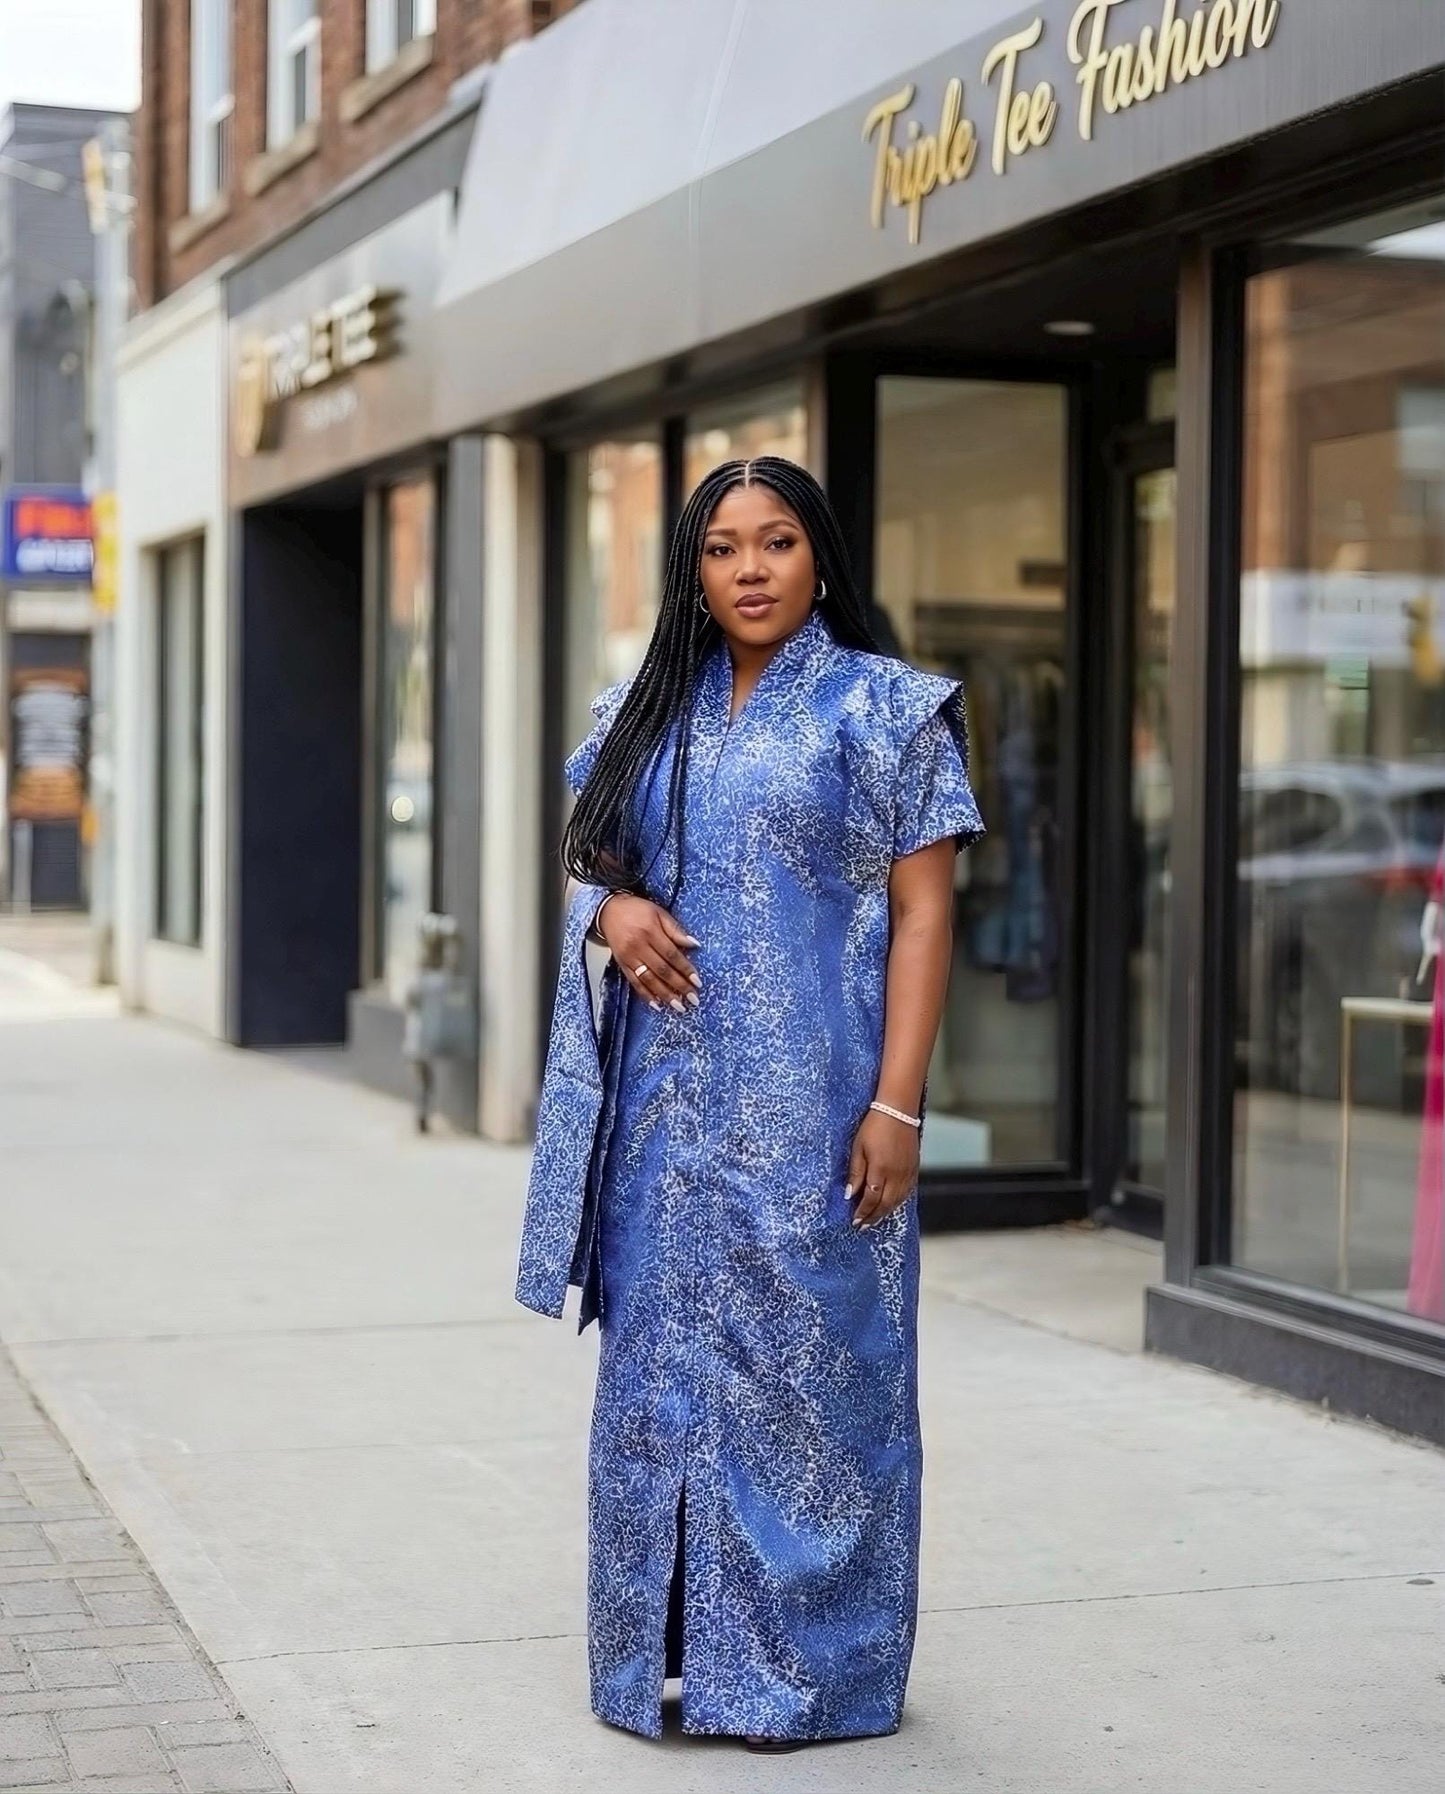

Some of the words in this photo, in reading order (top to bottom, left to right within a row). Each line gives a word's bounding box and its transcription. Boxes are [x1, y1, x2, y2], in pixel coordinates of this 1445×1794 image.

[861, 78, 977, 244] Triple
[981, 17, 1058, 175] Tee
[1067, 0, 1278, 140] Fashion
